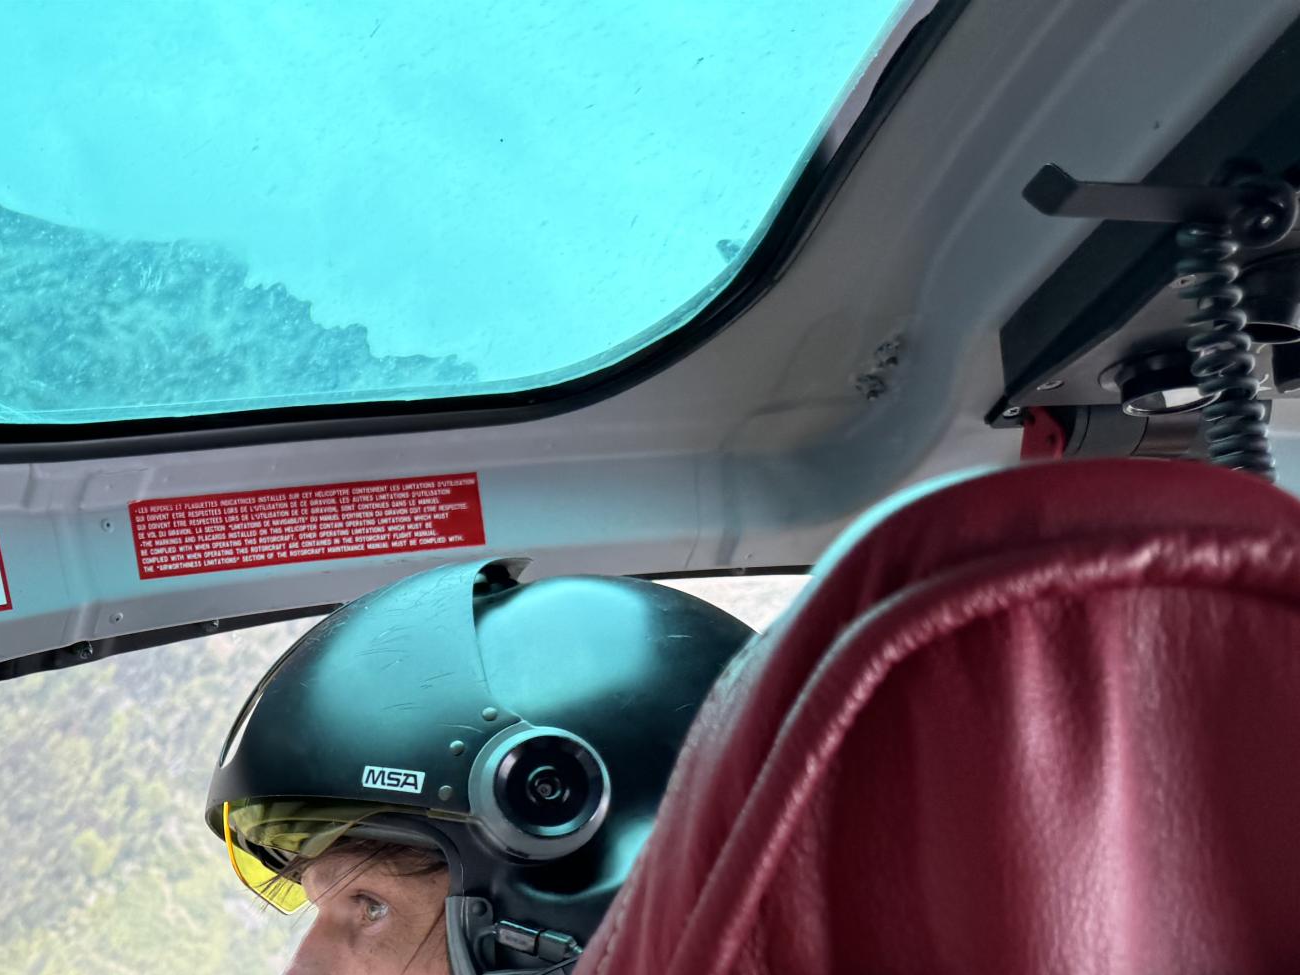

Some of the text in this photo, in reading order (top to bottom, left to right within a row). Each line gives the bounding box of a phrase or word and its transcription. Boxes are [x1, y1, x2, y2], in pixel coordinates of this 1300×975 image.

[184, 500, 217, 509] PLAQUETTES
[257, 494, 285, 502] INSTALLES
[314, 489, 349, 497] HELICOPTERE
[402, 481, 434, 489] LIMITATIONS
[187, 508, 221, 517] RESPECTEES
[249, 502, 288, 511] L'UTILISATION
[375, 491, 409, 500] LIMITATIONS
[147, 521, 170, 529] DOIVENT
[188, 517, 222, 525] RESPECTEES
[250, 511, 289, 520] L'UTILISATION
[357, 502, 389, 510] CONTENUES
[150, 546, 176, 554] COMPLIED
[211, 540, 241, 548] OPERATING
[319, 529, 349, 538] OPERATING
[351, 526, 384, 535] LIMITATIONS
[154, 537, 182, 545] MARKINGS
[197, 533, 225, 541] PLACARDS
[228, 530, 257, 538] INSTALLED
[284, 524, 316, 533] HELICOPTER
[319, 522, 343, 530] CONTAIN
[345, 519, 375, 527] OPERATING
[377, 516, 411, 524] LIMITATIONS
[142, 555, 168, 564] COMPLIED
[203, 549, 233, 557] OPERATING
[250, 544, 285, 553] ROTORCRAFT
[301, 539, 331, 548] CONTAINED
[354, 534, 390, 542] ROTORCRAFT
[392, 531, 411, 539] FLIGHT
[242, 554, 265, 562] SECTION
[289, 548, 324, 557] ROTORCRAFT
[327, 544, 364, 553] MAINTENANCE
[418, 536, 445, 544] COMPLIED
[365, 769, 419, 790] MSA
